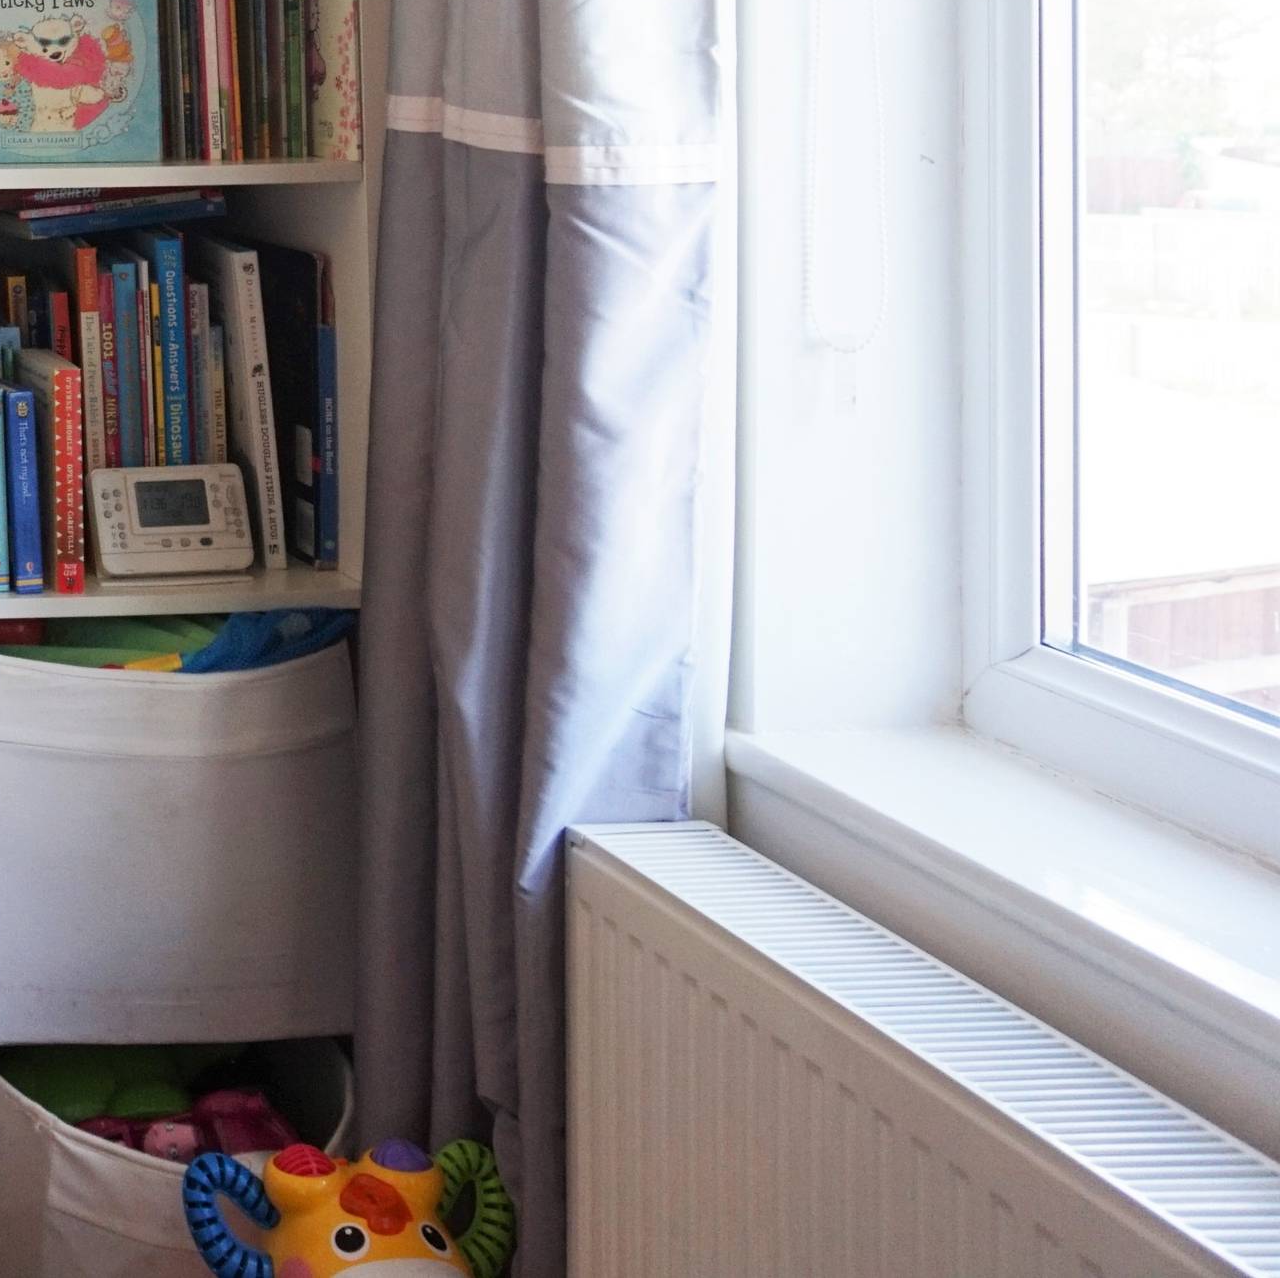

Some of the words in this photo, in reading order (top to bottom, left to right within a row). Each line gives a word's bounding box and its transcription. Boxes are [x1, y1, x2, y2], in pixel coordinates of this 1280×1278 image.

[211, 111, 221, 150] TEMPLAR
[166, 270, 179, 327] Questions
[85, 315, 95, 332] The
[102, 322, 113, 360] 1001
[87, 357, 97, 368] of
[168, 342, 180, 392] Answers
[88, 369, 97, 394] Peter
[214, 389, 223, 409] THE
[256, 380, 267, 426] HUGLESS
[106, 396, 118, 435] JOKES
[215, 413, 224, 439] JOLLY
[18, 421, 29, 446] That's
[19, 448, 28, 465] not
[260, 427, 273, 473] DOUGLAS
[66, 464, 74, 484] OPEN
[264, 475, 276, 506] FINDS
[67, 510, 75, 555] CAREFULLY
[268, 517, 278, 540] HUG!
